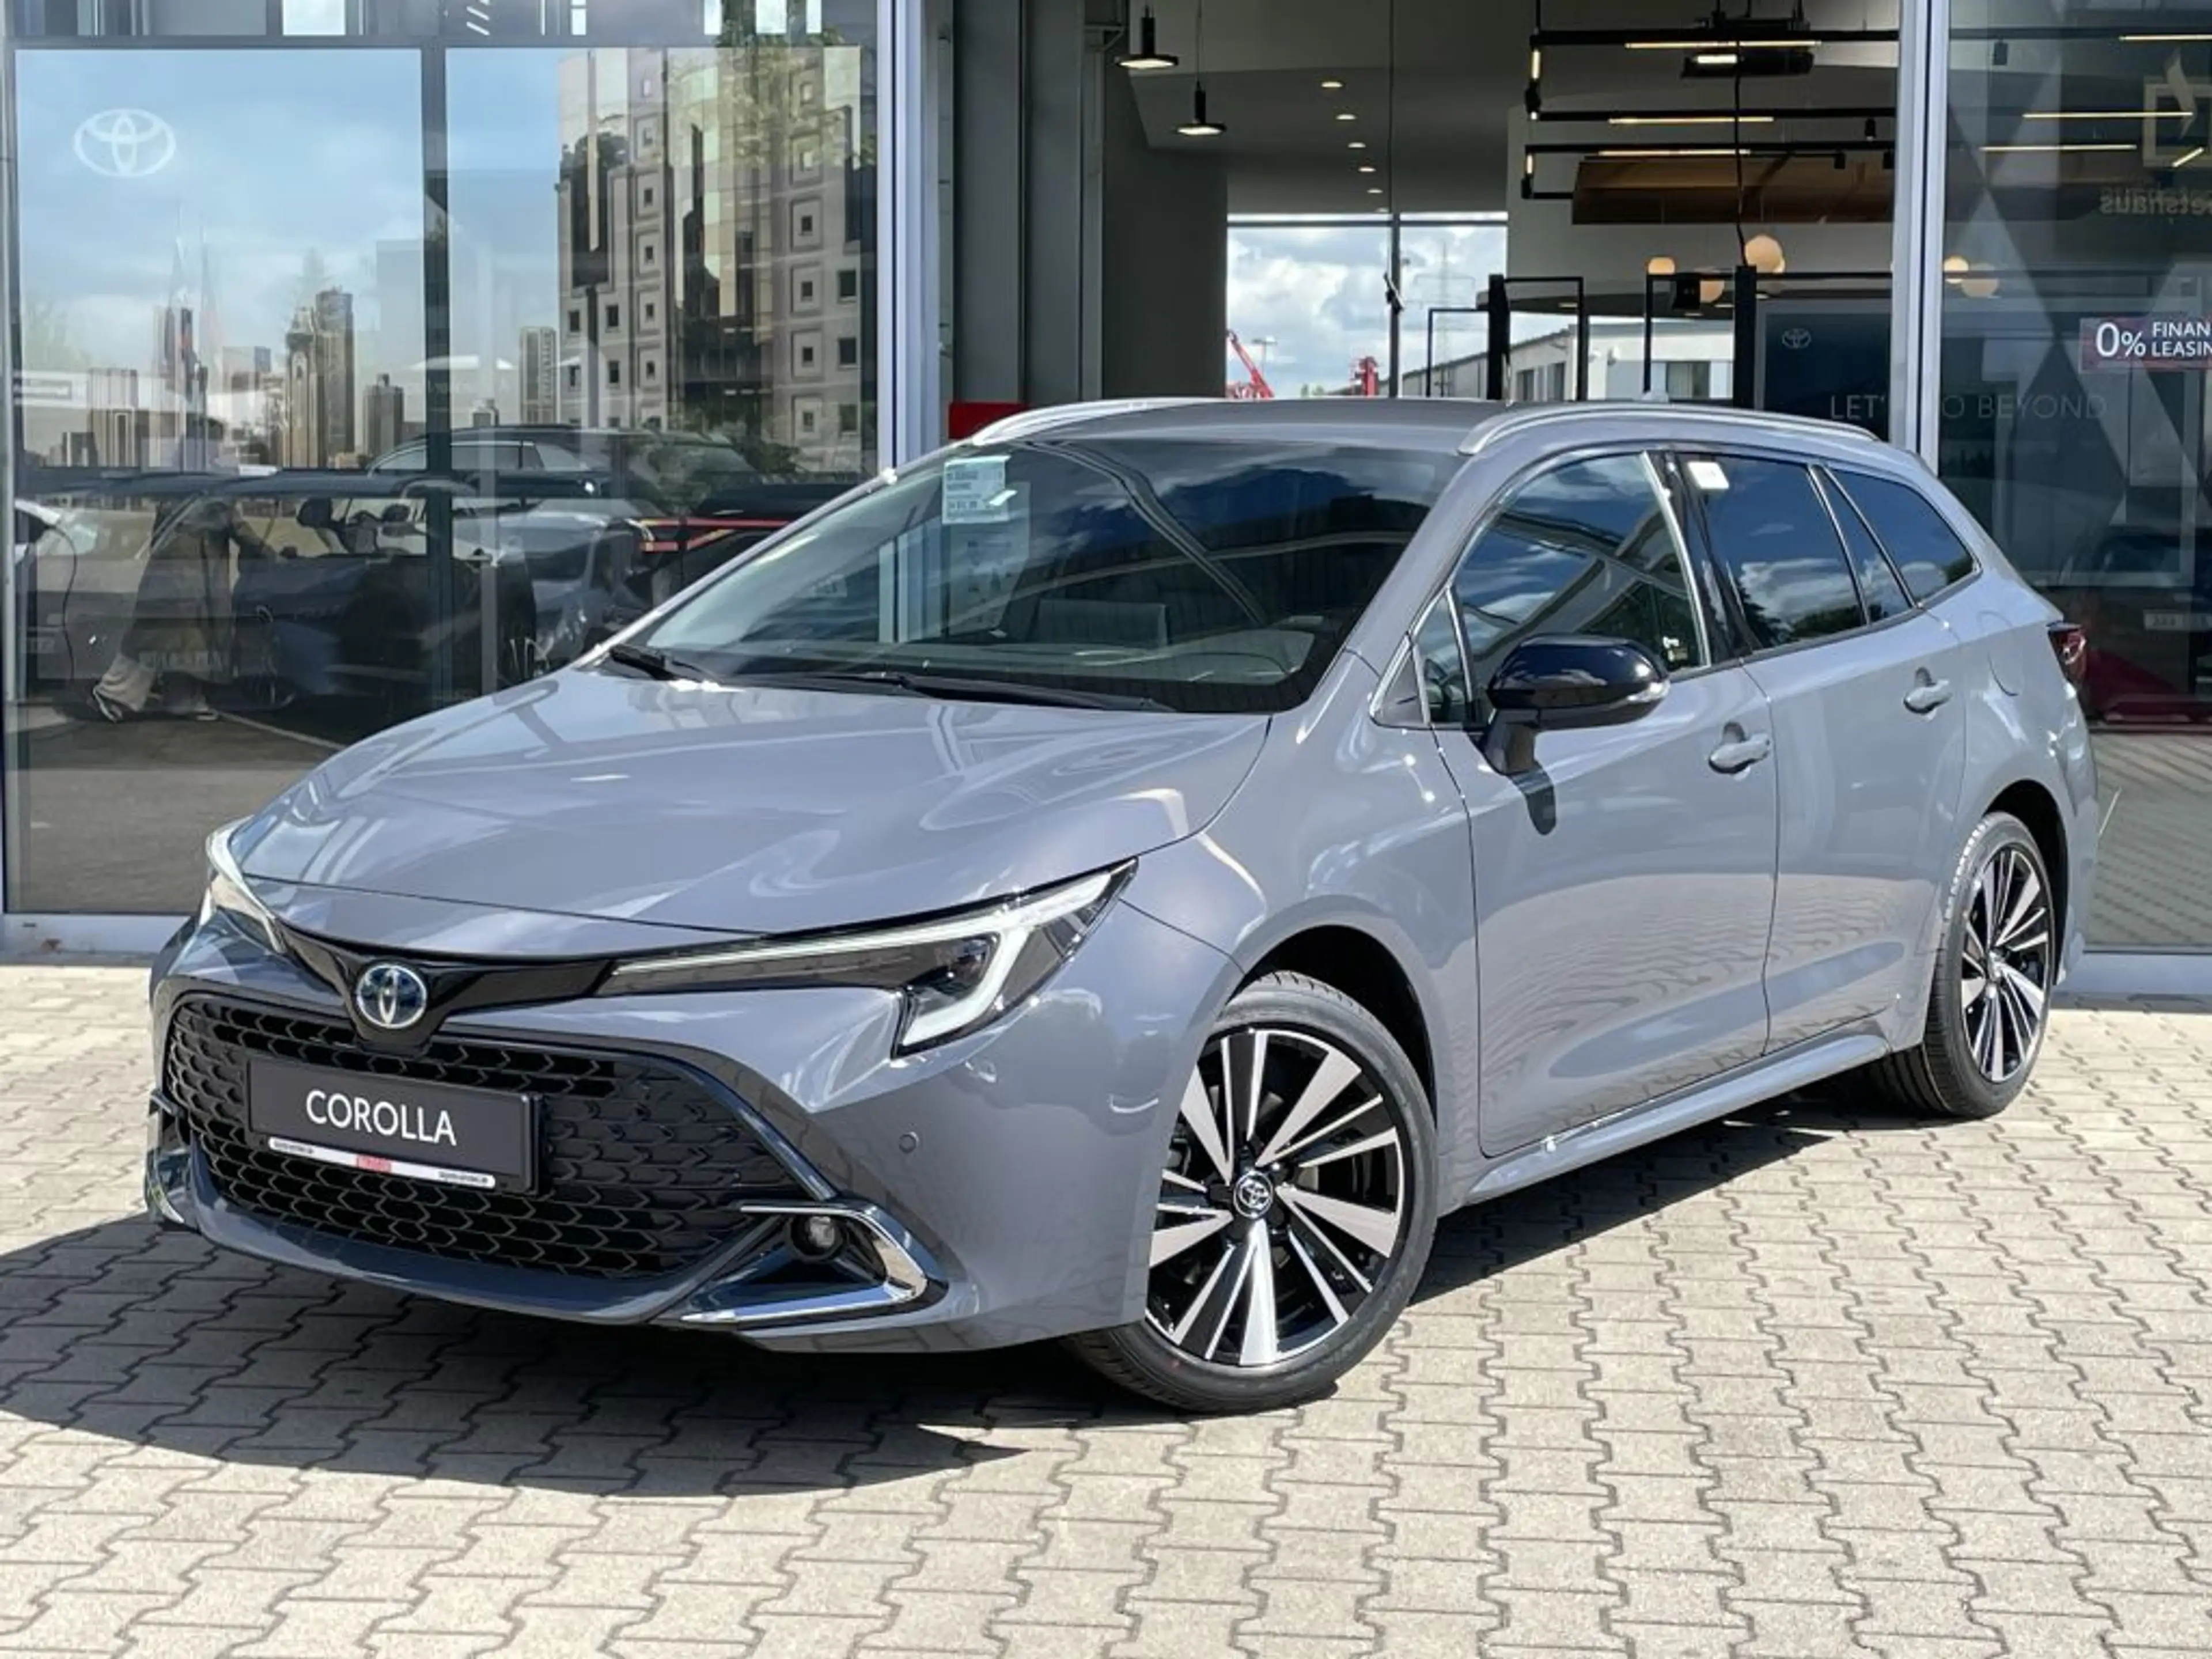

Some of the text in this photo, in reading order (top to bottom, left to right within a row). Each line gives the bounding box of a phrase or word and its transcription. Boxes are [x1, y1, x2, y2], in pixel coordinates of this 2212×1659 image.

[2096, 321, 2146, 358] 0%
[2152, 321, 2211, 338] FINAN
[2151, 341, 2212, 357] LEASIN
[1830, 395, 1886, 420] LET'
[1978, 395, 2107, 419] BEYOND
[306, 1089, 457, 1146] COROLLA
